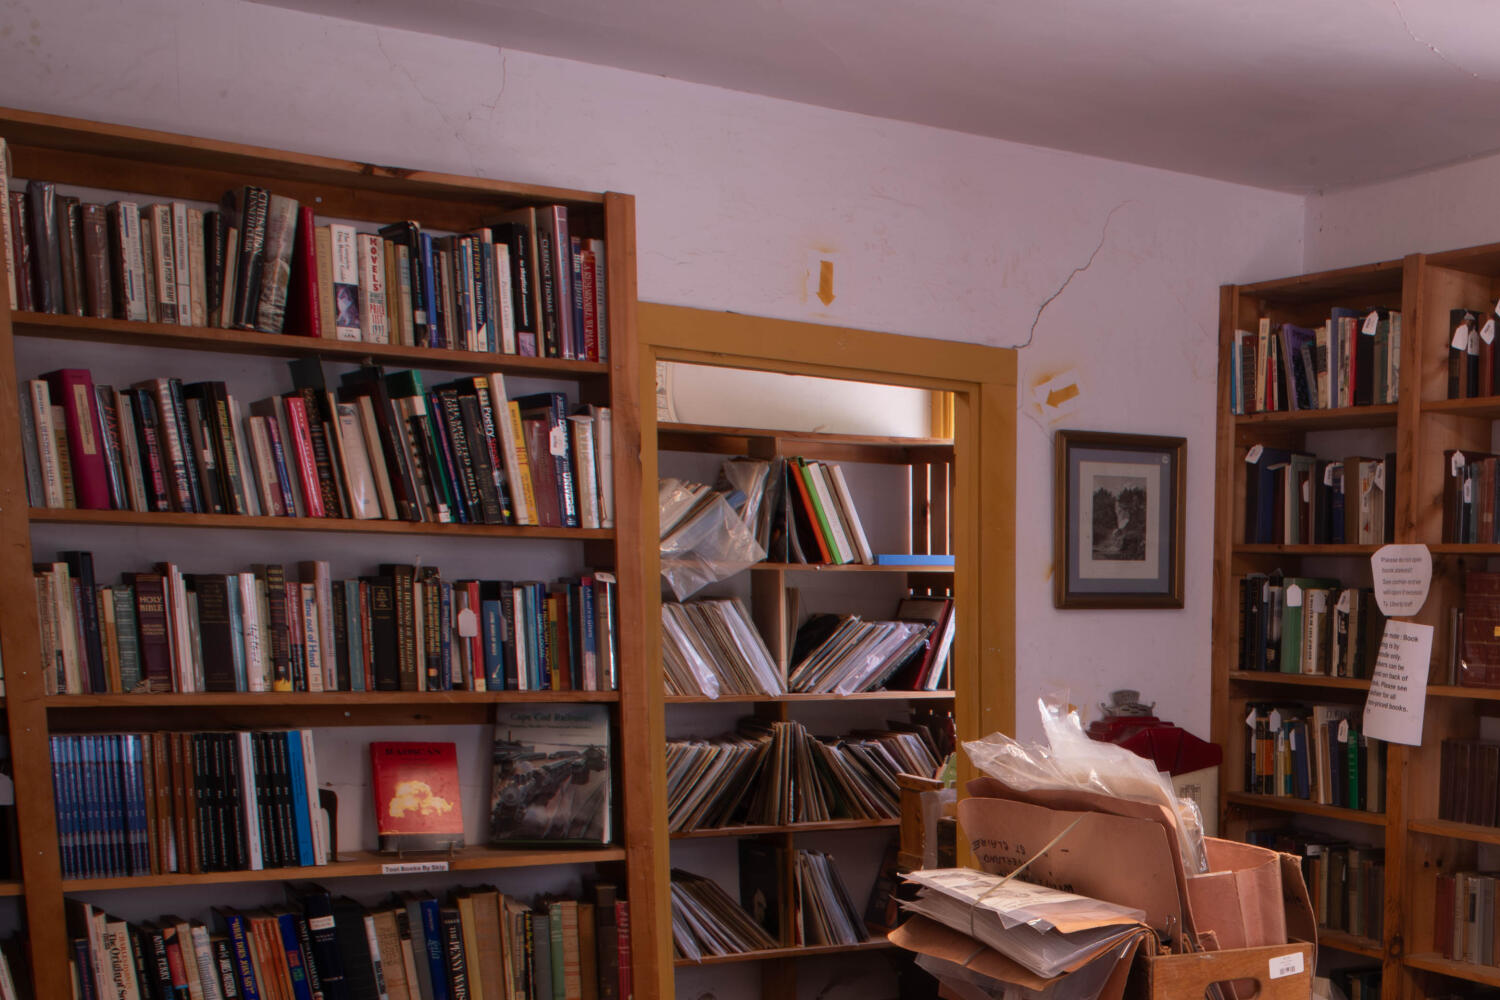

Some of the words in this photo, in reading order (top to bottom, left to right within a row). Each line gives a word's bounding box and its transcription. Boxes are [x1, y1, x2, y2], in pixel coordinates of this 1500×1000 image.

[484, 408, 495, 436] Poetry
[1402, 633, 1419, 642] Book
[308, 647, 318, 668] Hand
[1388, 702, 1409, 713] books.
[449, 941, 465, 974] PENNY
